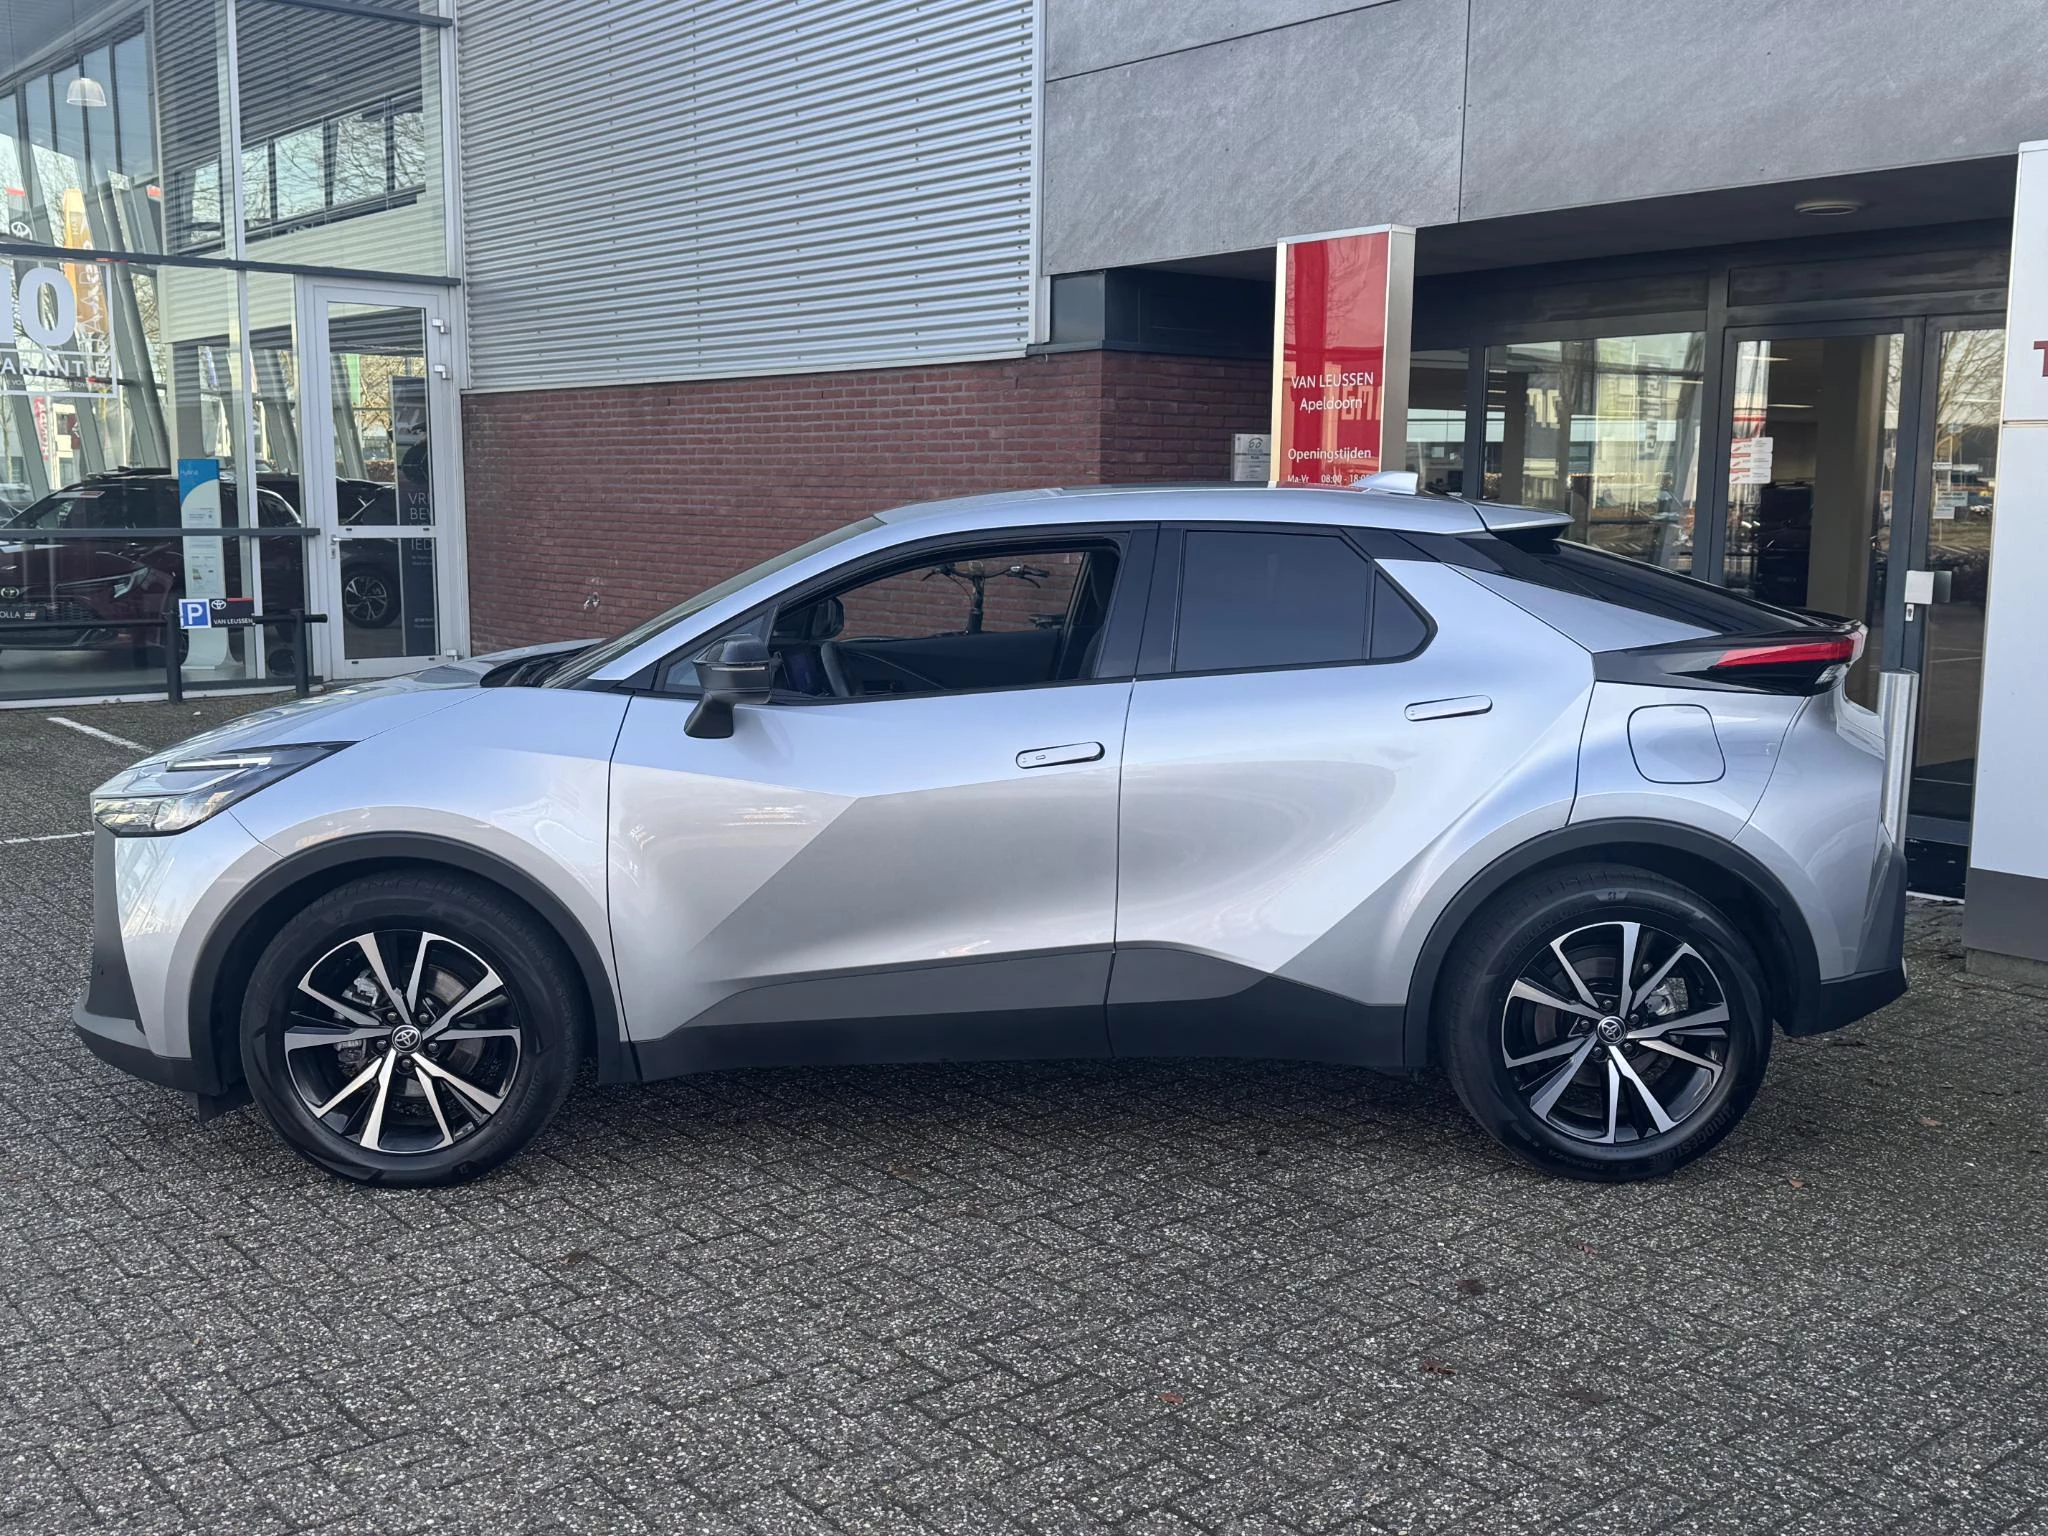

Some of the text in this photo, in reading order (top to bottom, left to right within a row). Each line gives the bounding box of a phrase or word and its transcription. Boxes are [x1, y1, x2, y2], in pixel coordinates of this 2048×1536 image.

[1291, 371, 1374, 389] VAN LEUSSEN
[1299, 395, 1363, 414] Apeldoorn
[1287, 447, 1372, 463] Openingstijden
[1287, 474, 1310, 483] Ma-Vr
[1321, 474, 1342, 484] 08:00
[186, 603, 203, 625] P
[227, 617, 253, 625] LEUSSEN
